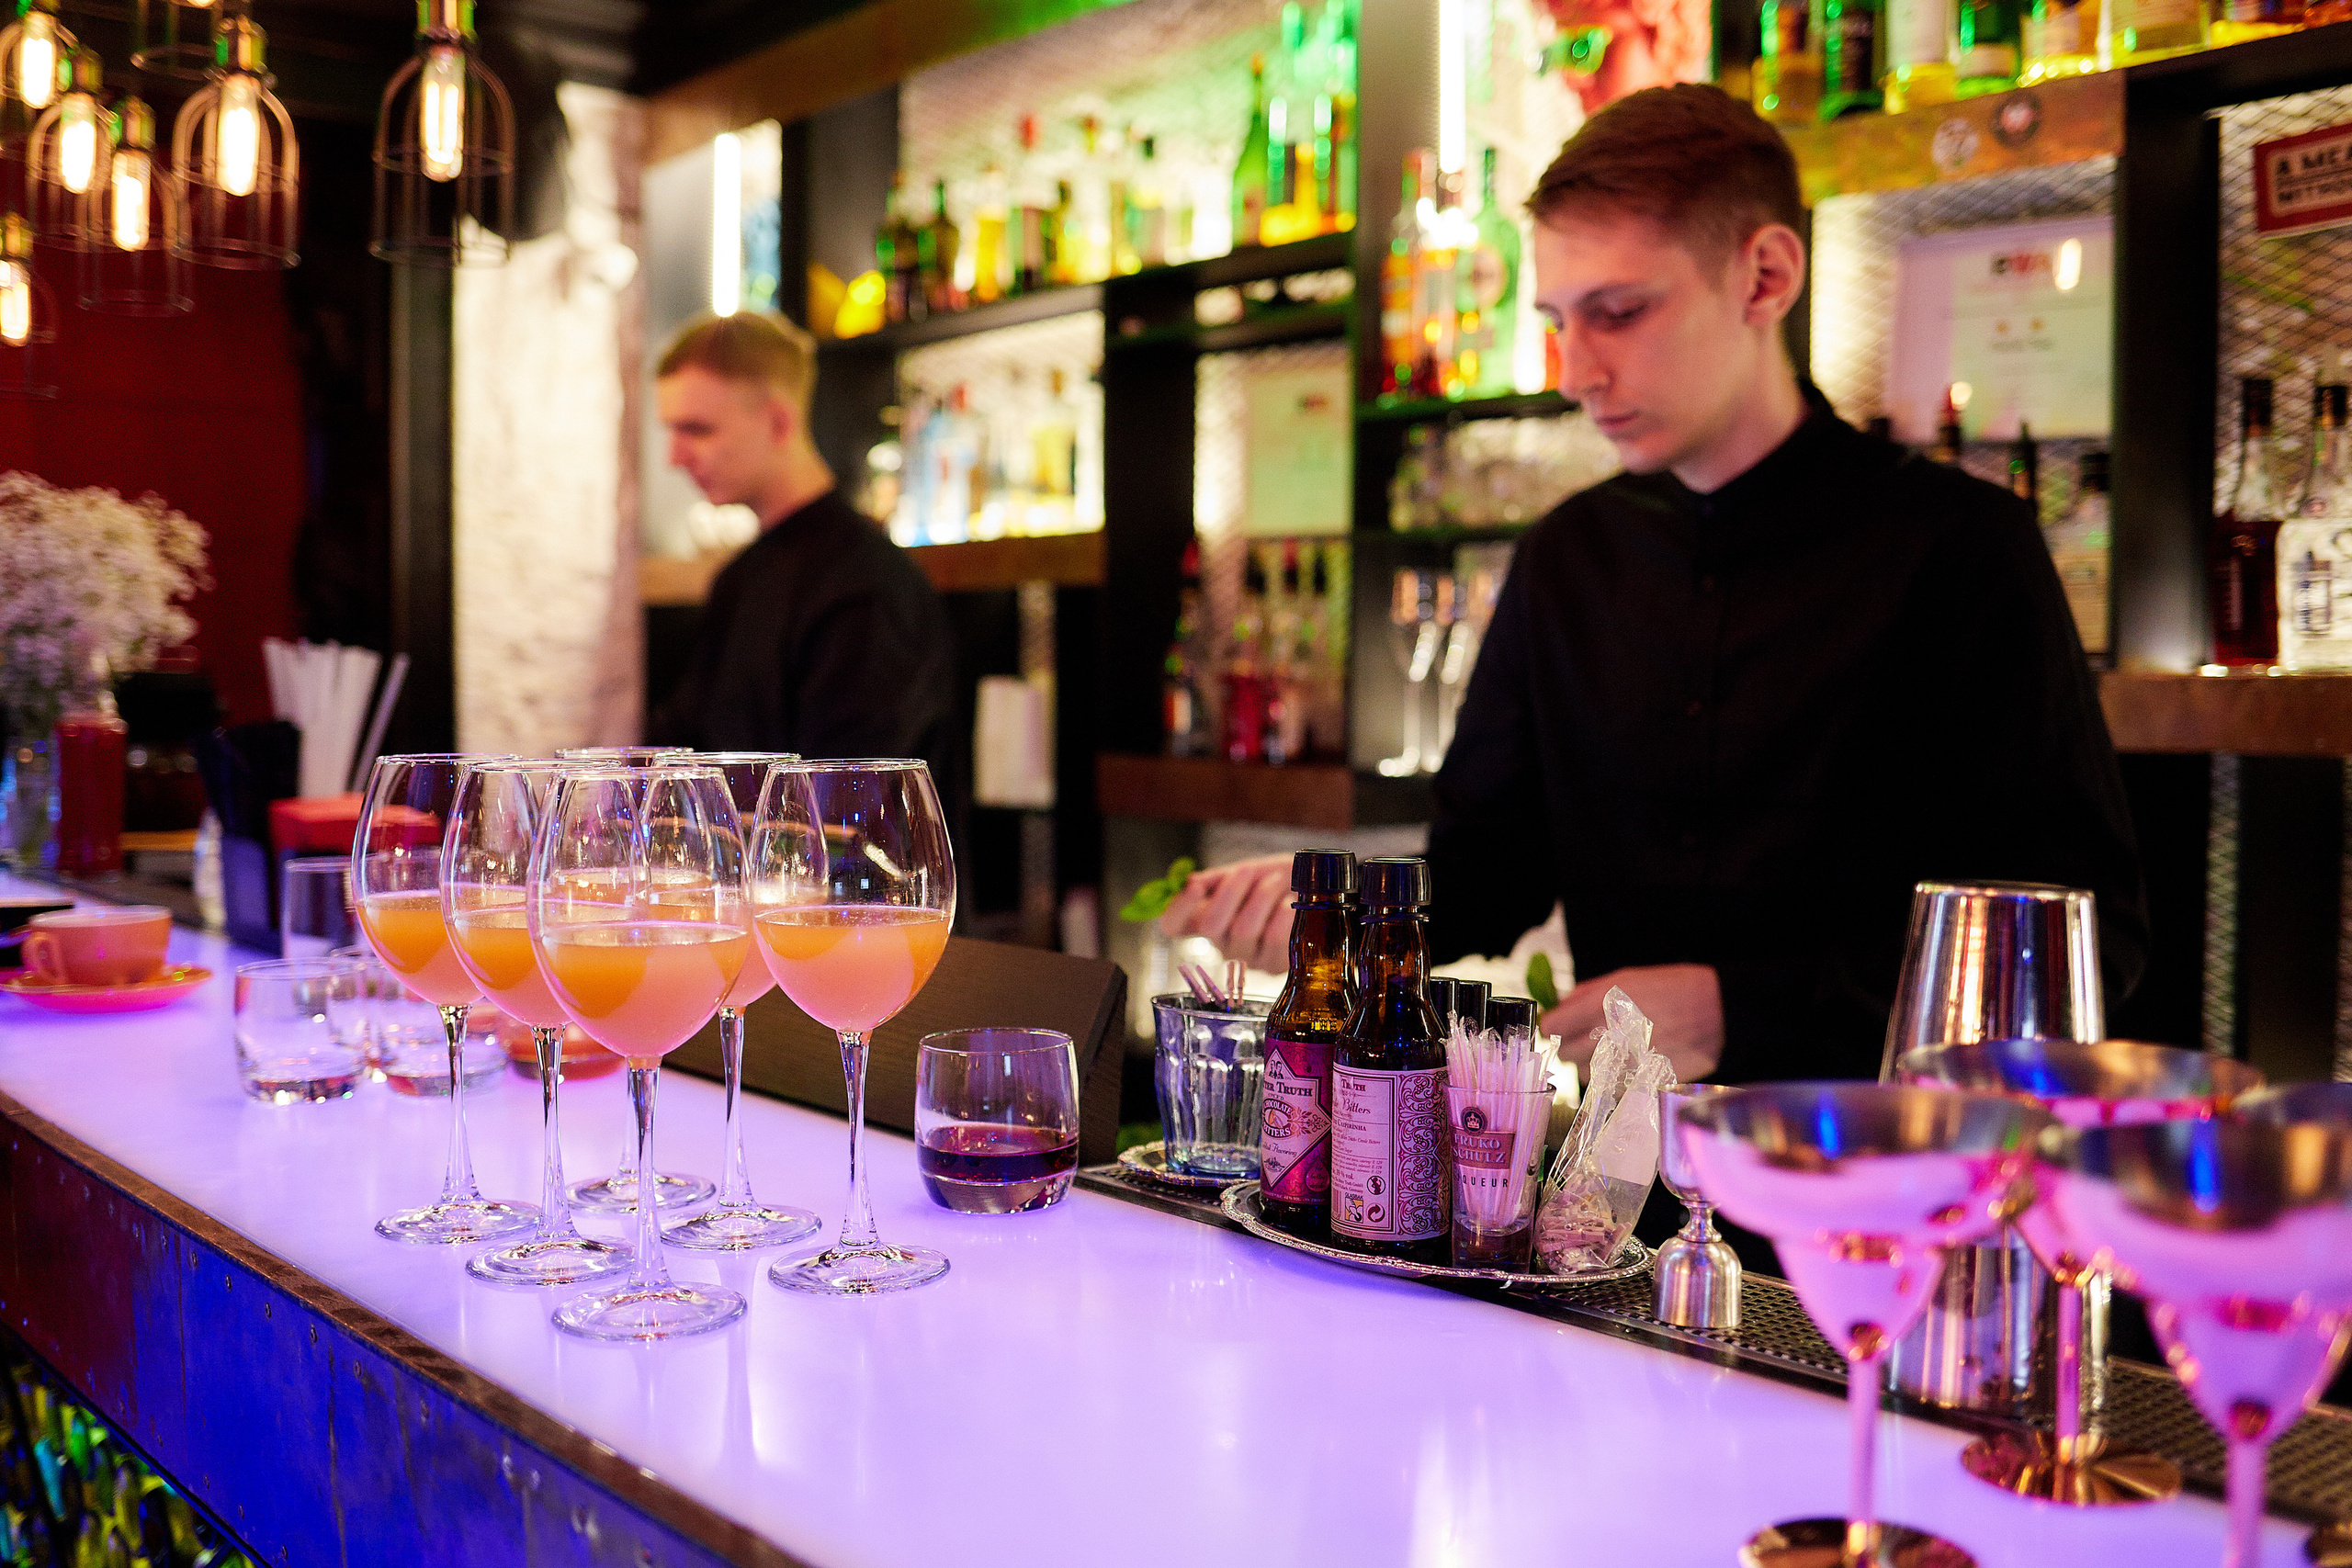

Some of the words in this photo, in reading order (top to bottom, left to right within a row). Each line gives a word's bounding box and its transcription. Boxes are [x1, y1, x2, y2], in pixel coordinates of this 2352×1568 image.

[1276, 1081, 1314, 1097] TRUTH
[1341, 1098, 1371, 1114] Bitters
[1454, 1133, 1501, 1150] FRUKO
[1453, 1146, 1506, 1164] SCHULZ
